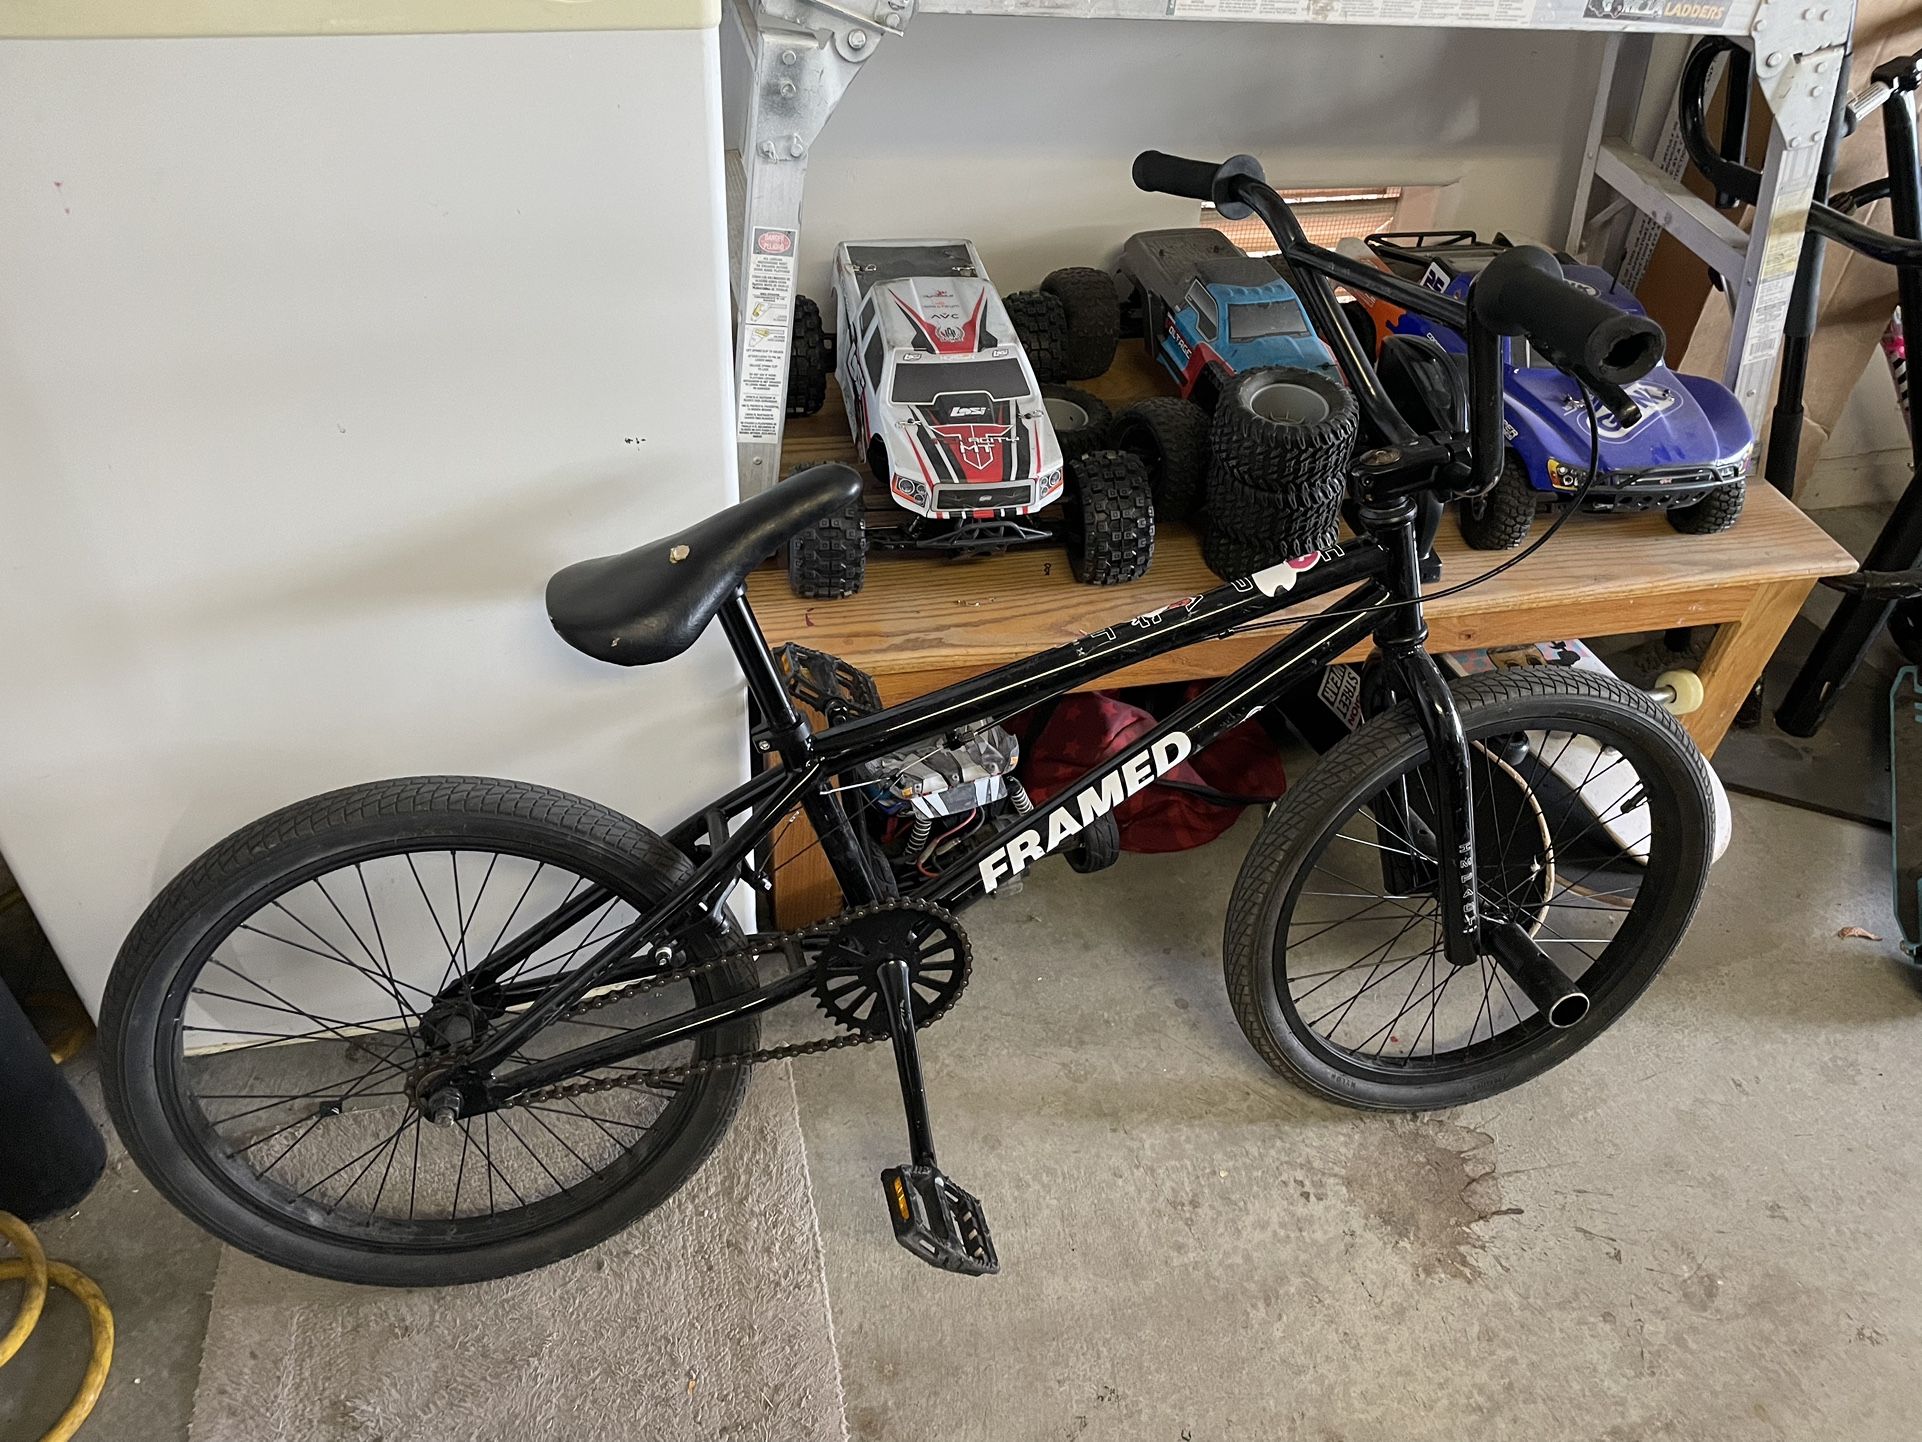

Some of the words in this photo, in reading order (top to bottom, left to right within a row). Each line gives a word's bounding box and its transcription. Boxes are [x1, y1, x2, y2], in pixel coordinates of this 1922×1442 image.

[1663, 2, 1725, 20] LADDERS
[1168, 325, 1192, 360] OLTAGE
[1336, 671, 1358, 719] STREET
[978, 731, 1192, 894] FRAMED
